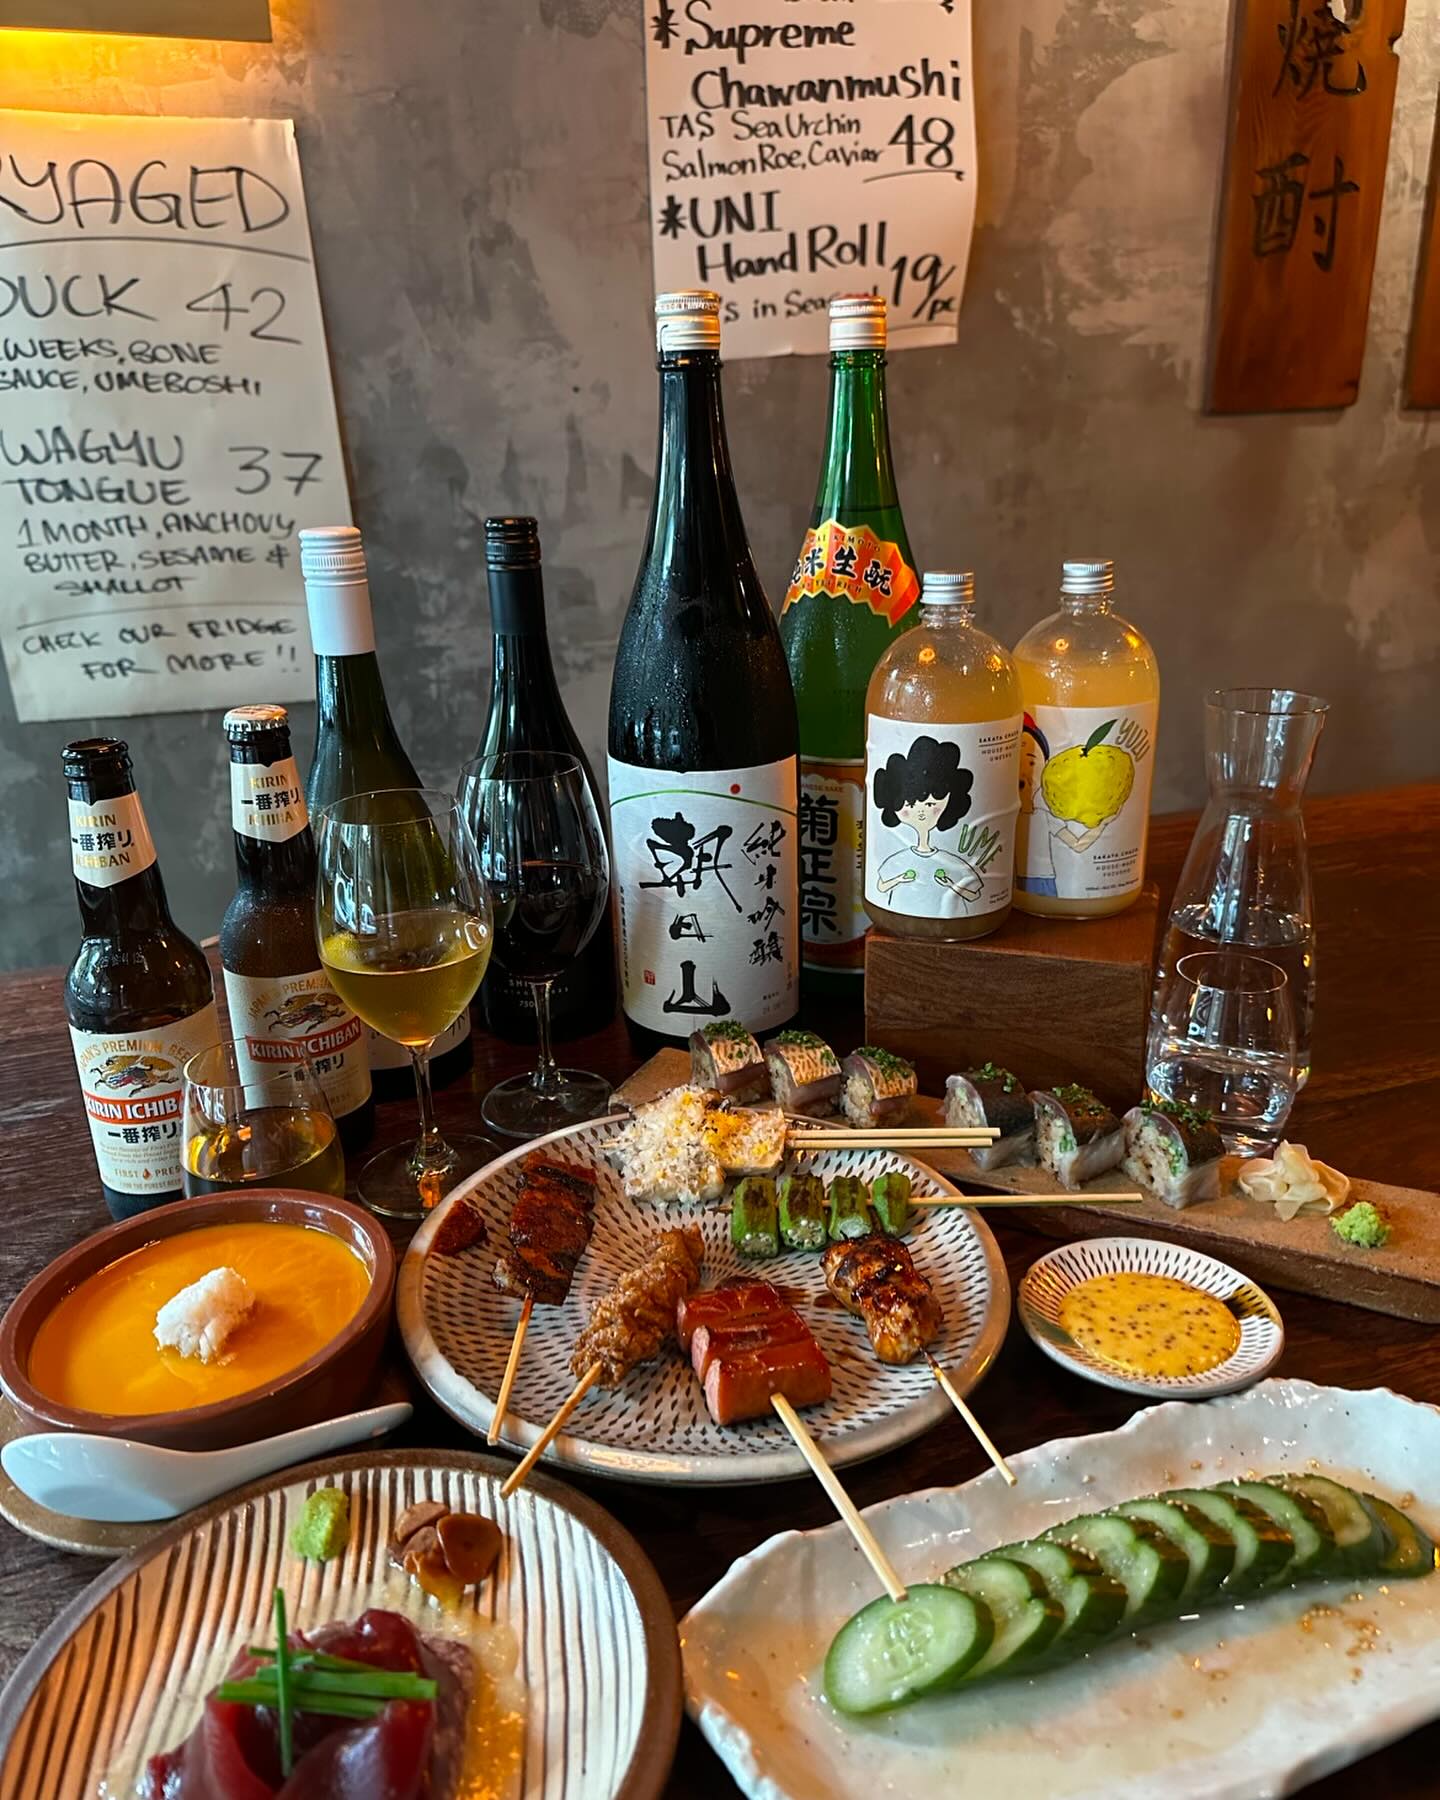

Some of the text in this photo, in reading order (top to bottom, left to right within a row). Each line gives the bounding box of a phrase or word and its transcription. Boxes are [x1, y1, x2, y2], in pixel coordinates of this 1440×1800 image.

[685, 0, 855, 64] Supreme
[691, 58, 961, 110] Chawanmushi
[659, 111, 715, 141] TAS
[888, 114, 955, 169] 48
[0, 154, 289, 232] YAGED
[690, 190, 781, 238] UNI
[697, 221, 887, 283] Hand Roll
[186, 282, 302, 344] 42
[753, 299, 777, 318] in
[128, 340, 221, 364] BONE
[94, 371, 261, 395] UMEBOSHI
[0, 426, 323, 496] WAGYU 37
[2, 478, 190, 505] TONGUE
[164, 512, 296, 540] ANCHOVY
[139, 547, 256, 568] SESAME
[54, 577, 198, 596] SHALLOT
[23, 618, 297, 655] CHECK OUR FRIDGE
[81, 659, 158, 680] FOR
[1115, 717, 1151, 763] YUZU
[251, 774, 288, 790] KIRIN
[240, 788, 301, 811] 一番搾り
[72, 829, 133, 852] 一番搾り
[958, 823, 1003, 874] UME
[102, 1040, 163, 1054] PREMIUM
[251, 1043, 293, 1059] KIRIN
[86, 1098, 184, 1120] KIRIN ICHIB
[108, 1123, 177, 1144] 一番搾り
[155, 1166, 181, 1177] PRES
